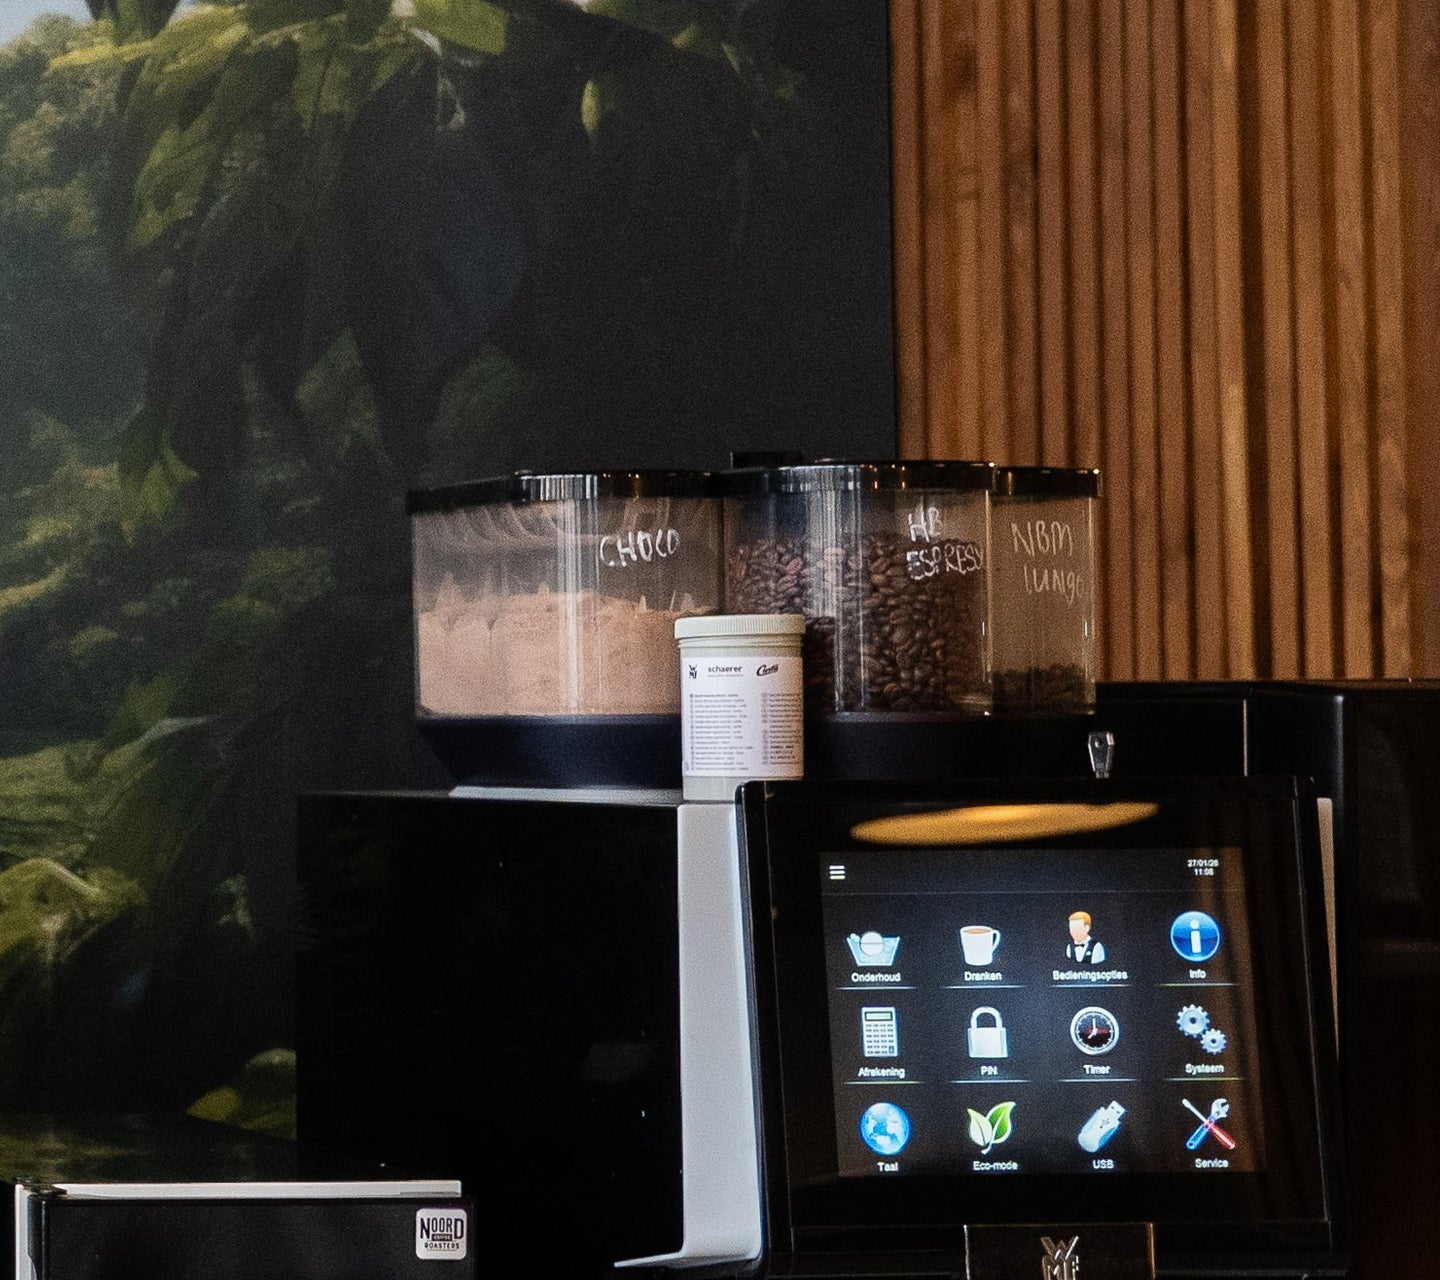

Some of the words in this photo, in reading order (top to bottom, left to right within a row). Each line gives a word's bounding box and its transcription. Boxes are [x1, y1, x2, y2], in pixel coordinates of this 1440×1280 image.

[600, 529, 680, 567] CHOCO
[851, 972, 901, 982] Onderhoud
[964, 971, 1002, 981] Dranken
[1052, 970, 1128, 981] Bedieningsopties
[1189, 969, 1206, 979] Info
[858, 1067, 906, 1079] Afrekening
[981, 1066, 998, 1076] PIN
[1083, 1064, 1110, 1074] Timer
[1185, 1063, 1225, 1075] Systeem
[877, 1161, 899, 1171] Taal
[973, 1160, 1018, 1170] Eco-mode
[1092, 1159, 1115, 1169] USB
[1195, 1158, 1229, 1168] Service
[420, 1217, 464, 1239] NOORD
